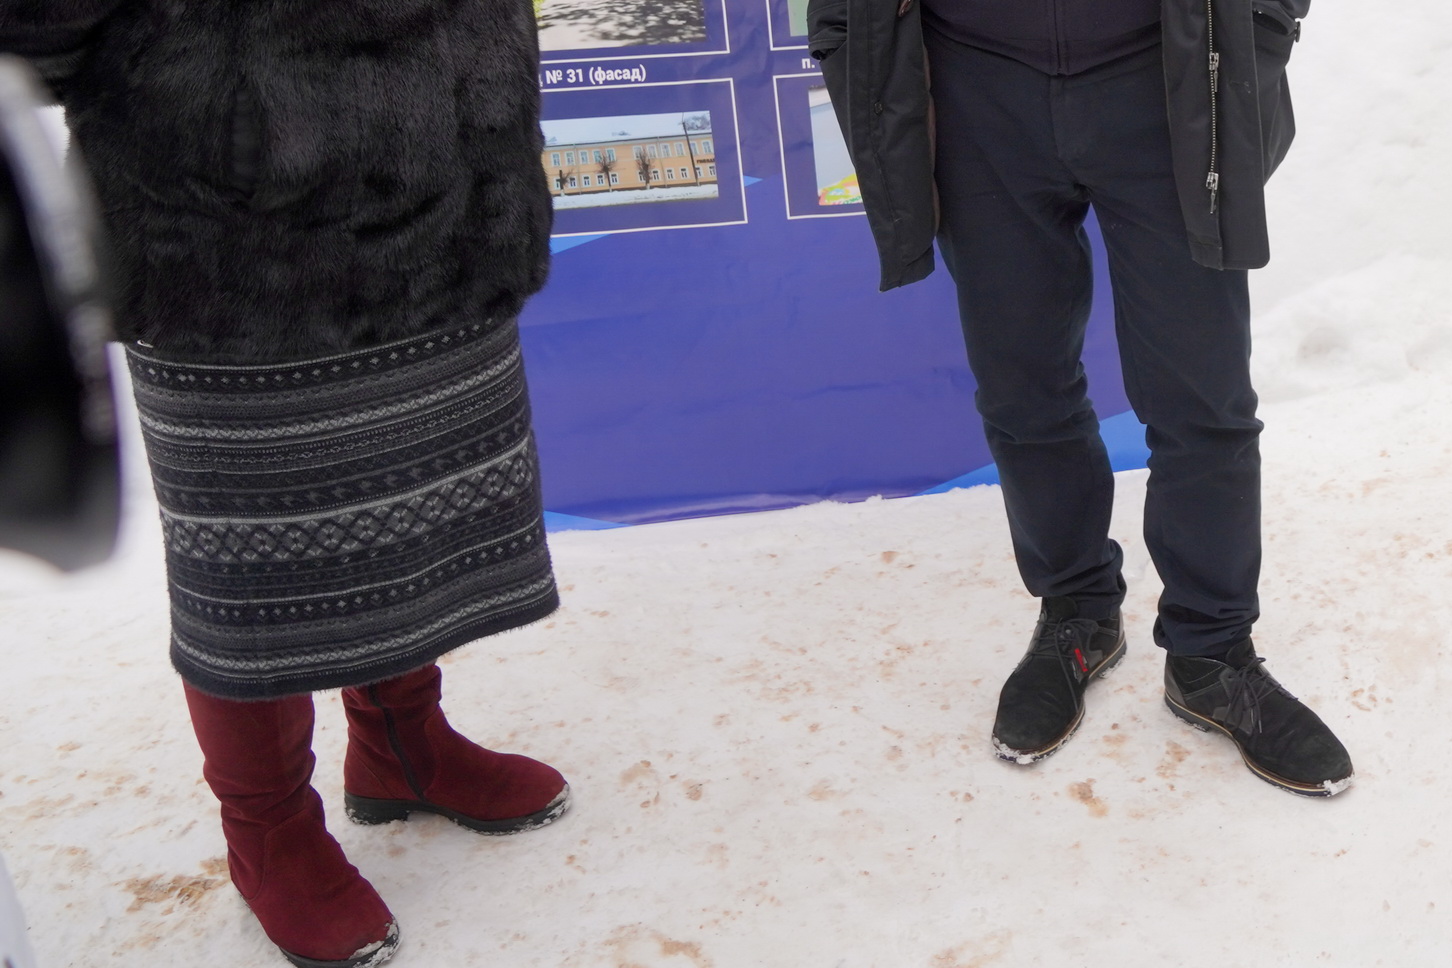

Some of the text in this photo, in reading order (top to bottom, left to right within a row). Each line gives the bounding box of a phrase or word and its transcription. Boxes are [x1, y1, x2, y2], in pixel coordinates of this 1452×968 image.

[545, 69, 563, 84] №
[566, 68, 584, 83] 31
[589, 63, 647, 85] (фасад)
